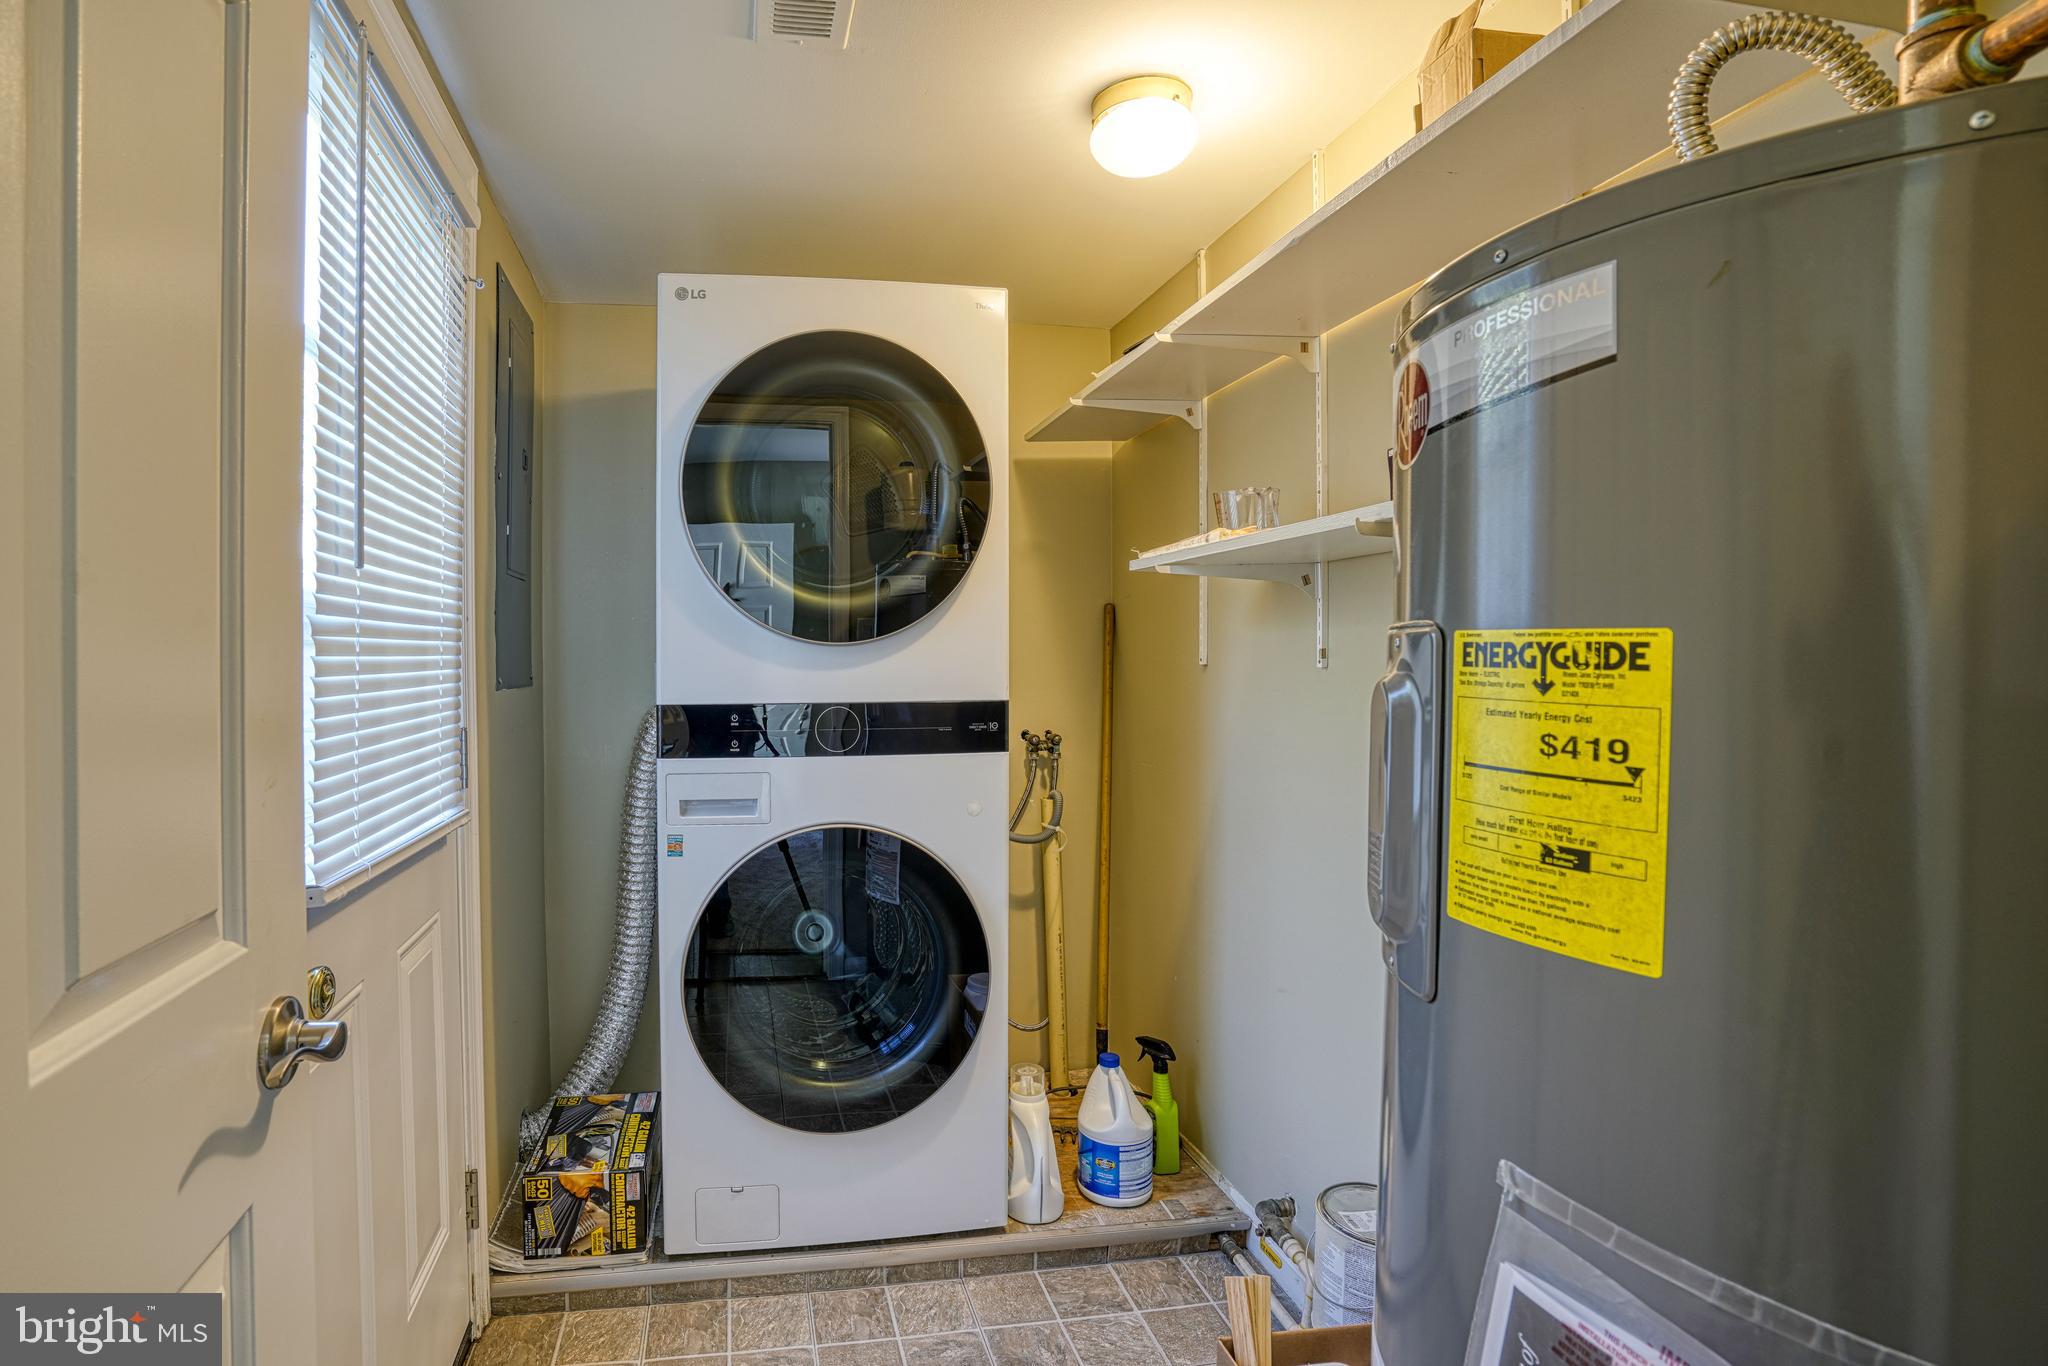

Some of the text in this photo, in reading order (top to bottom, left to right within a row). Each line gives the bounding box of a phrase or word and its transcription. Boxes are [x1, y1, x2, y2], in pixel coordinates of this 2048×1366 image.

[690, 289, 706, 299] LG
[1454, 278, 1607, 348] PROFESSIONAL
[1485, 707, 1592, 724] Estimated Yearly Energy Cost
[1539, 732, 1630, 764] $419
[639, 1120, 651, 1130] 42
[536, 1179, 549, 1199] 50
[615, 1173, 626, 1231] CONTRACTOR
[626, 1205, 636, 1218] 42
[627, 1218, 637, 1249] GALLON
[1604, 1329, 1621, 1346] THIS
